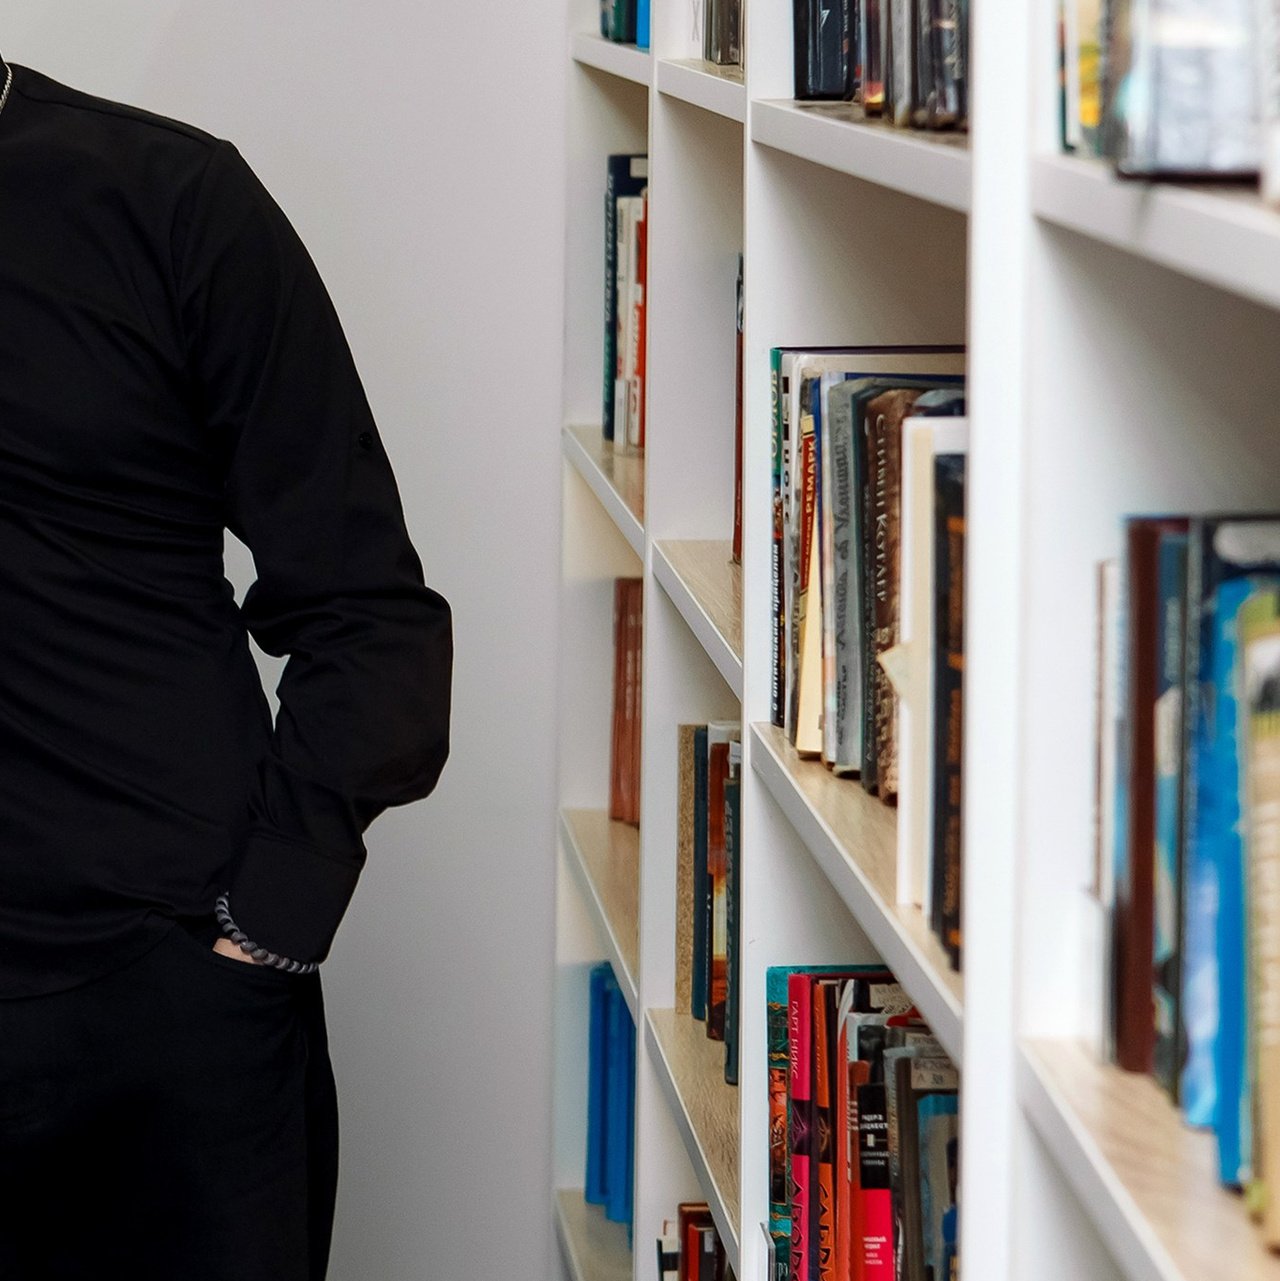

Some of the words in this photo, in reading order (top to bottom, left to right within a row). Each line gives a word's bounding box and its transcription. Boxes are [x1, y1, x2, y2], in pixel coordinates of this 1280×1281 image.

[806, 440, 816, 514] РЕМАРК
[791, 1000, 799, 1034] ГАРТ
[791, 1038, 799, 1079] НИКС
